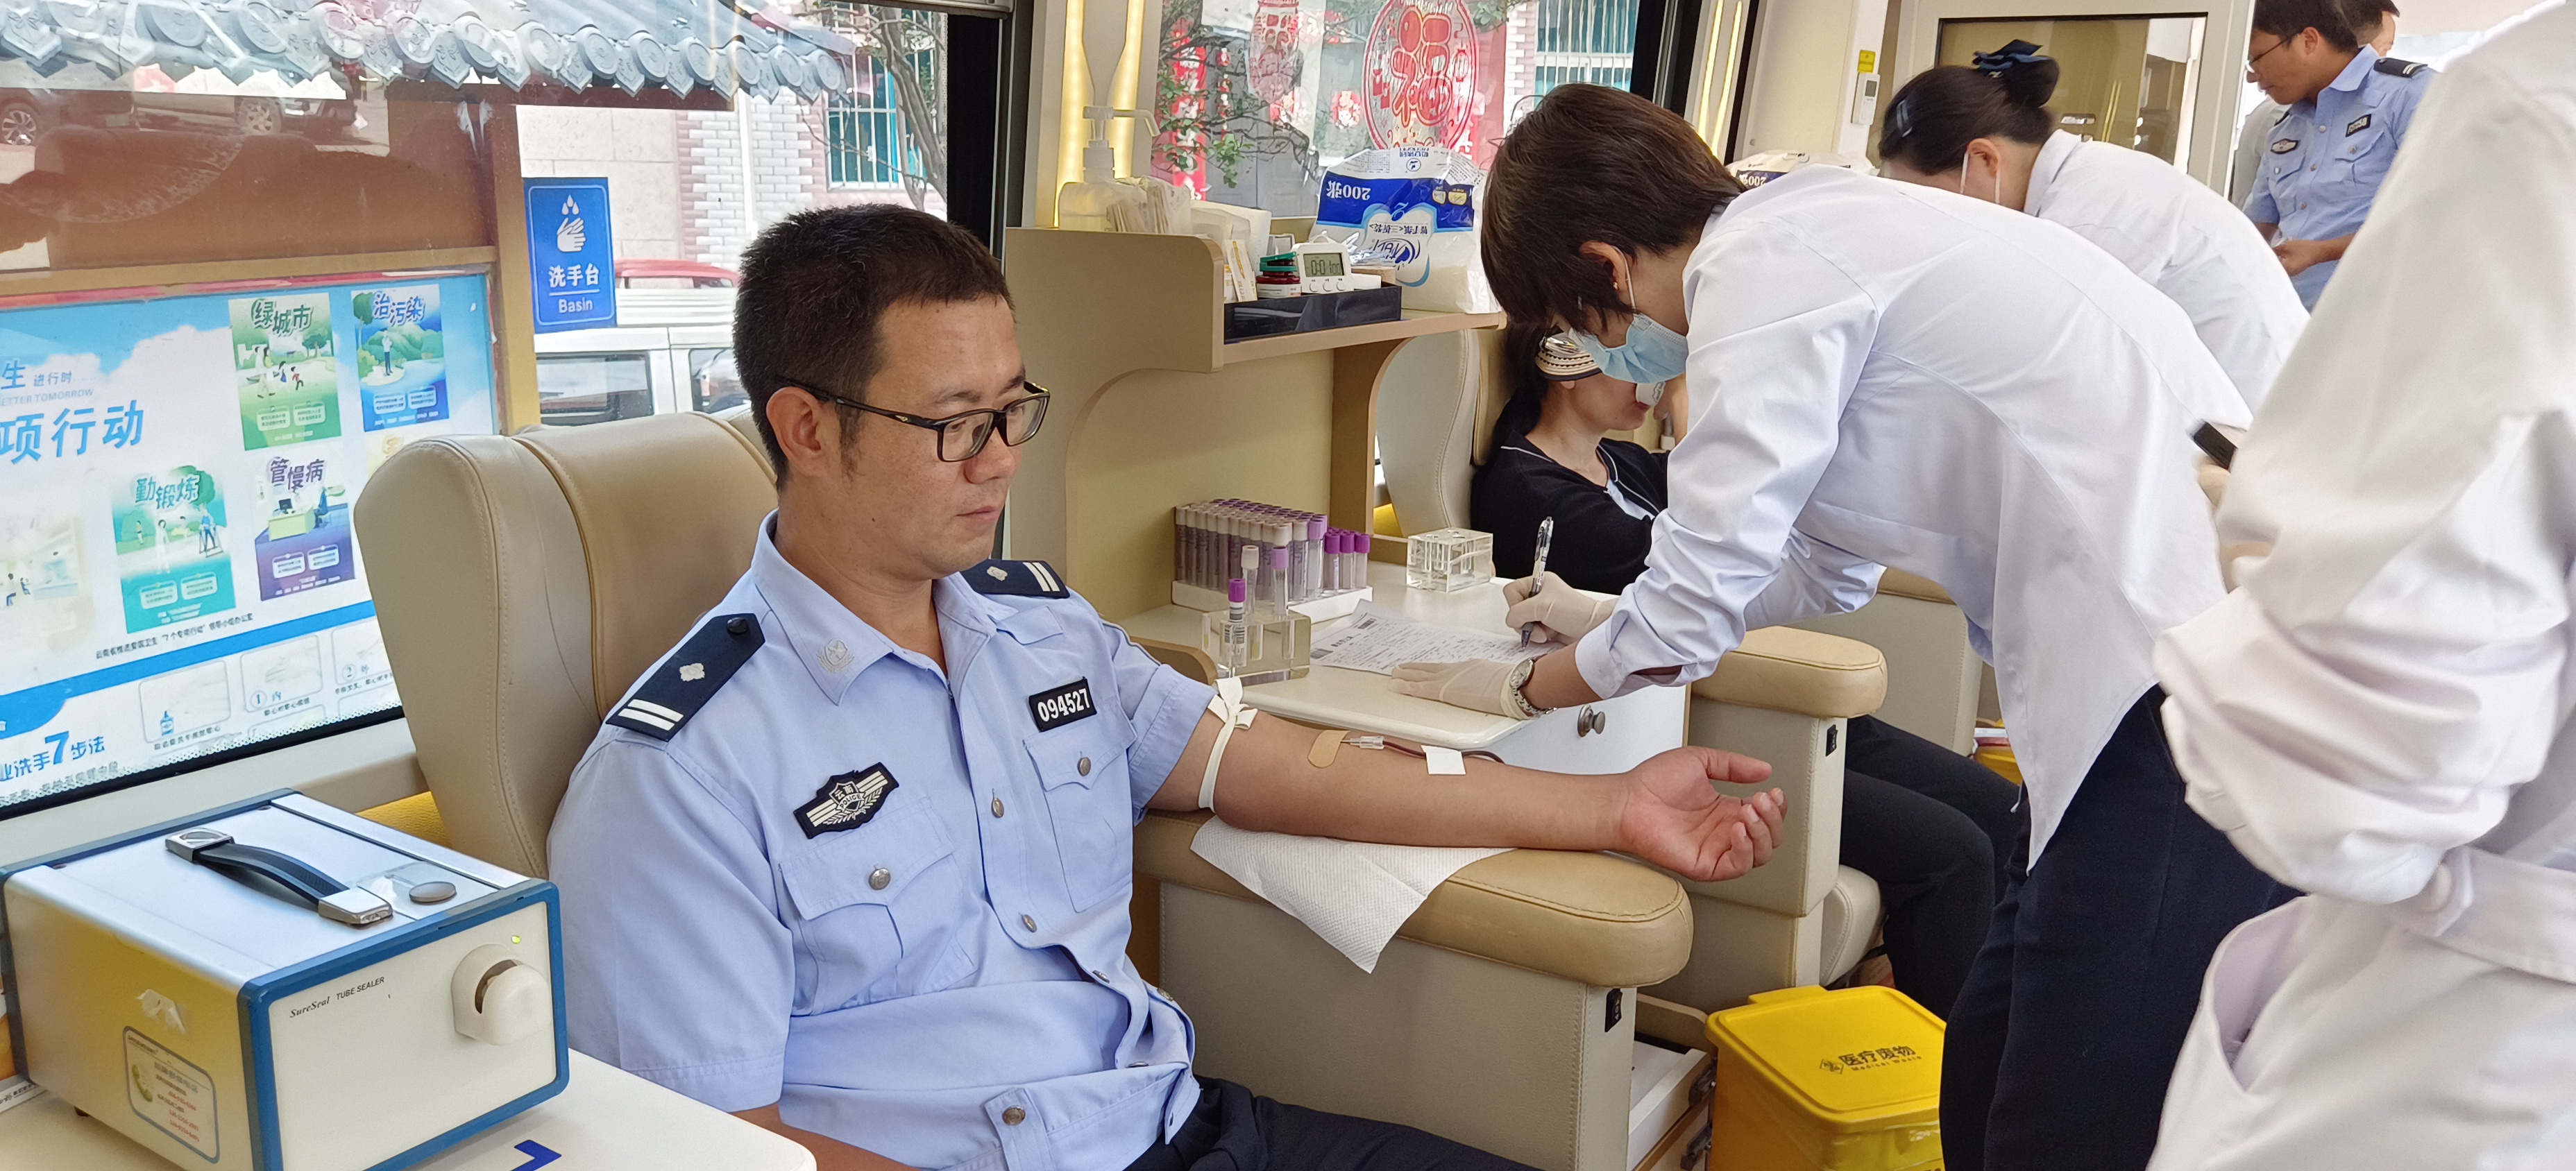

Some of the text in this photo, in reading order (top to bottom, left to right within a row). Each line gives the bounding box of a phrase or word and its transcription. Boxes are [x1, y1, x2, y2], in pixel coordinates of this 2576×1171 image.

[1326, 180, 1371, 200] 200张
[548, 263, 600, 288] 洗手台
[254, 299, 312, 334] 绿城市
[373, 291, 425, 326] 治污染
[558, 297, 593, 314] Basin
[0, 360, 26, 389] 生
[35, 388, 94, 402] TOMORROW
[0, 400, 144, 465] 项行动
[270, 456, 325, 491] 管慢病
[135, 474, 201, 509] 勤锻炼
[1037, 687, 1090, 722] 094527
[834, 784, 854, 800] 云南
[839, 793, 861, 809] POLICE
[289, 976, 385, 1018] SureSeal TUBE SEALER
[1838, 1045, 1916, 1067] 医疗废物
